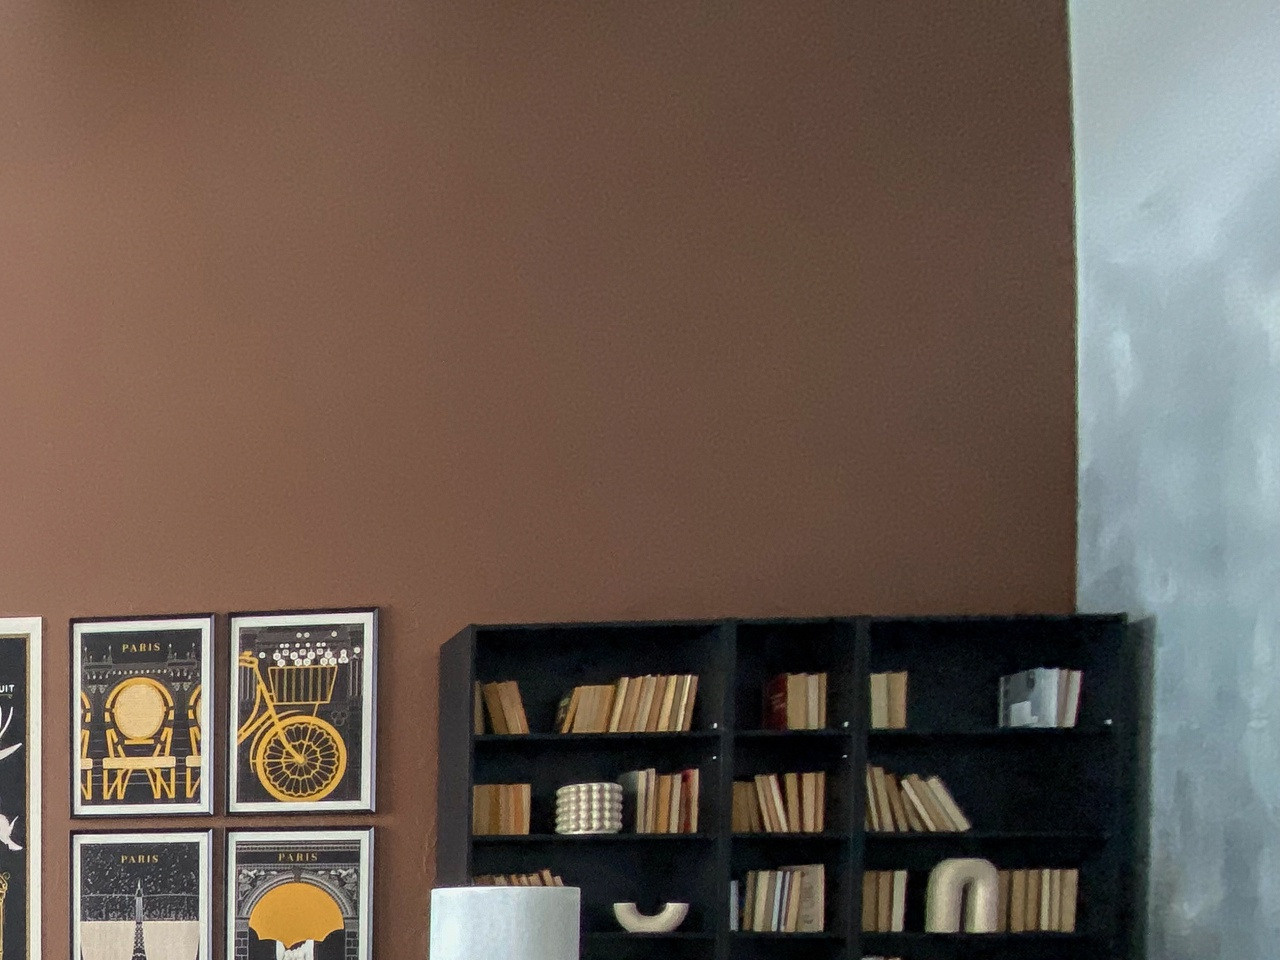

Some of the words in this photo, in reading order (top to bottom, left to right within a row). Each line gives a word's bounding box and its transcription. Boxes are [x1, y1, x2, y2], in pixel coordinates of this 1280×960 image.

[121, 642, 161, 653] PARIS
[120, 854, 159, 863] PARIS
[278, 852, 318, 862] PARIS
